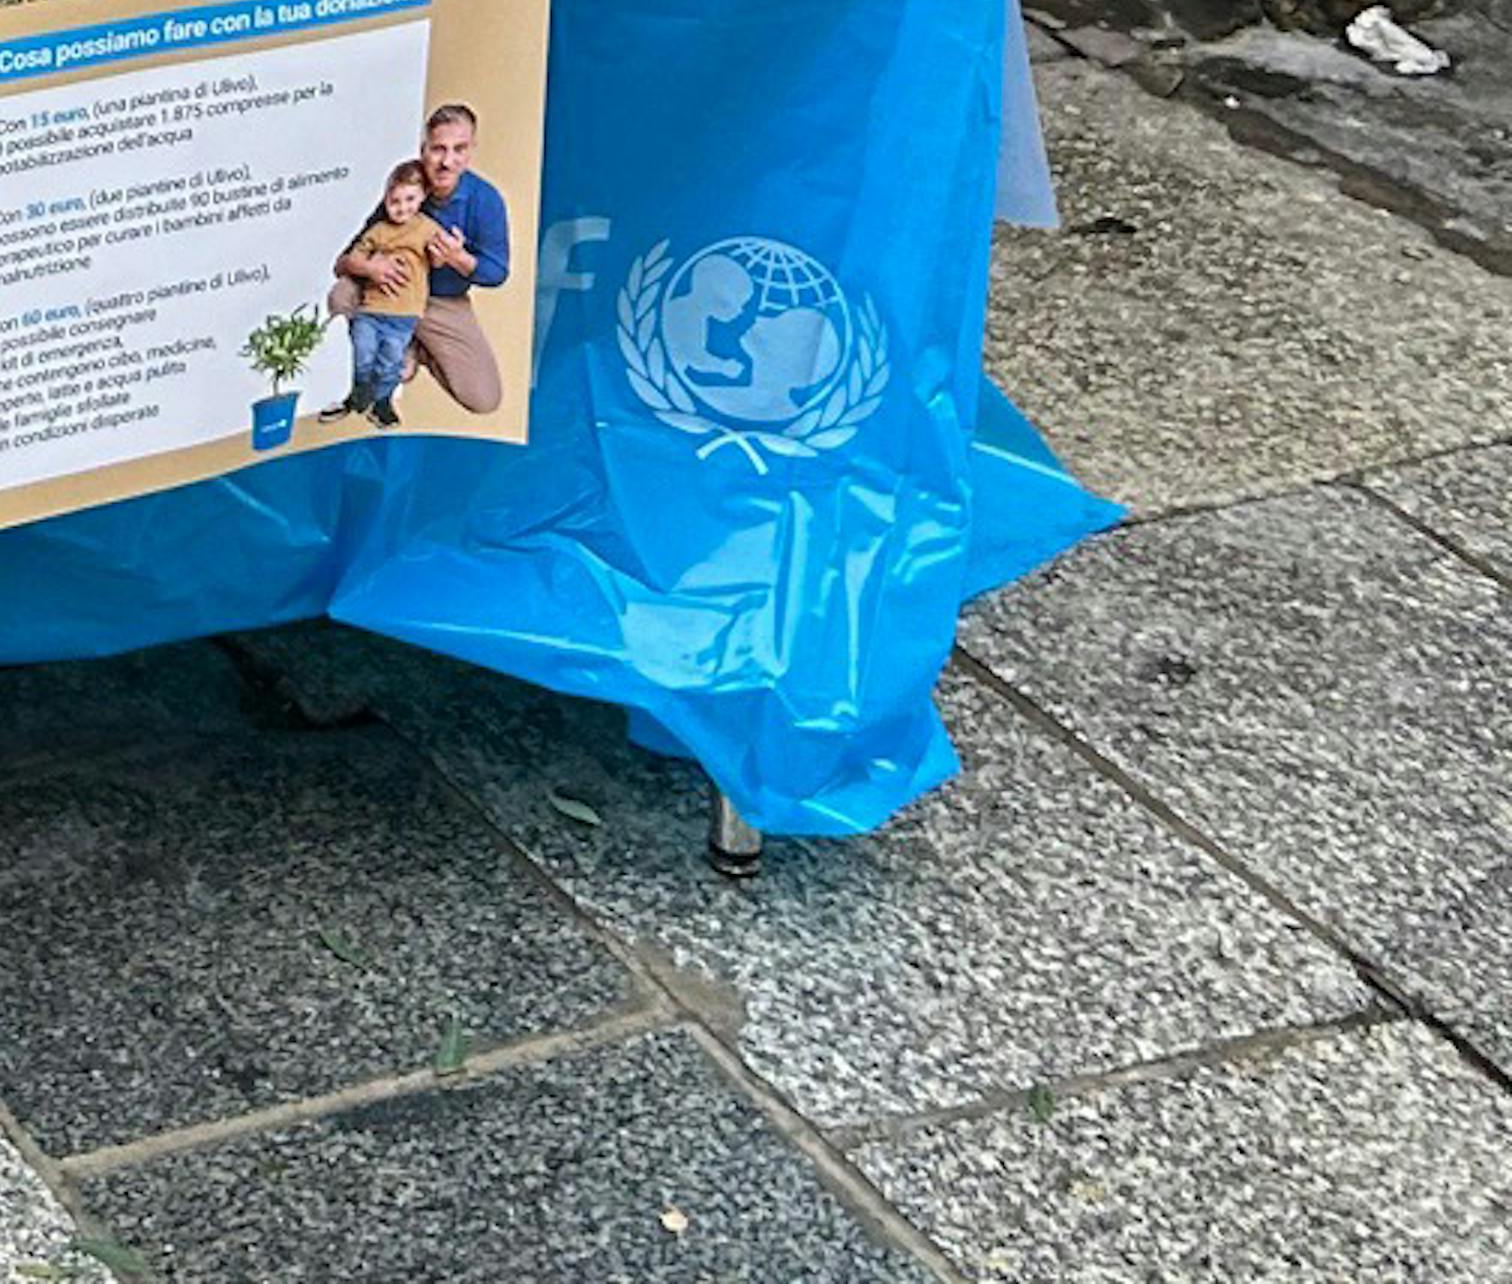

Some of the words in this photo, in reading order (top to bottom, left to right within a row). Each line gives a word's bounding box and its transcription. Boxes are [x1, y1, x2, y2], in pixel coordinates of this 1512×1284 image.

[55, 27, 159, 70] possiamo
[163, 18, 207, 45] fare
[210, 11, 250, 36] con
[254, 3, 274, 29] la
